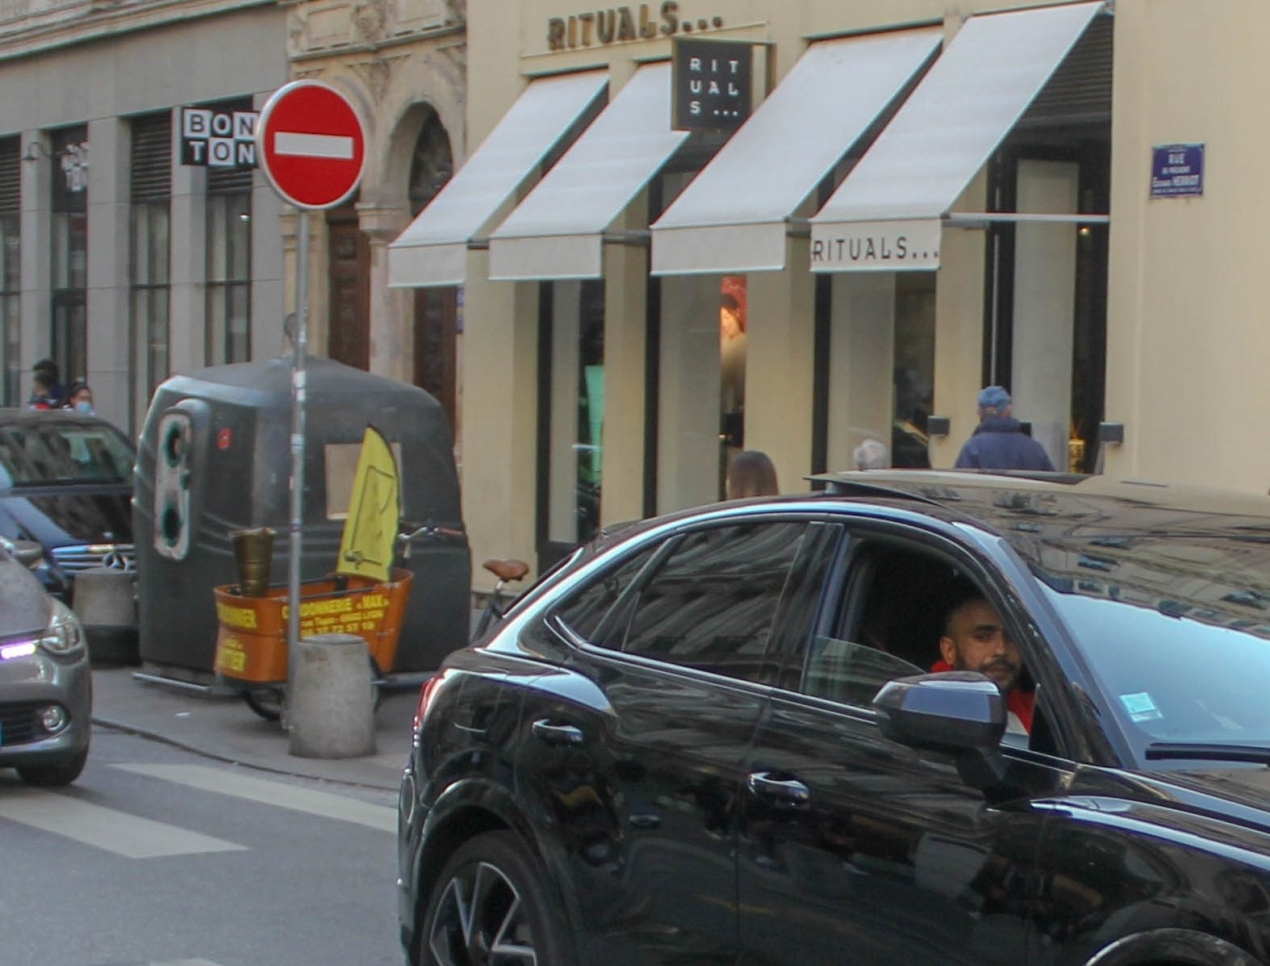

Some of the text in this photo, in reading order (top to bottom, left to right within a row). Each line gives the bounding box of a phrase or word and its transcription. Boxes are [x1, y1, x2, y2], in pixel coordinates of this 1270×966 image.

[547, 1, 723, 50] RITUALS...
[190, 113, 255, 136] BON
[188, 141, 255, 164] TON
[1168, 153, 1185, 165] RUE
[812, 236, 939, 261] RITUALS...
